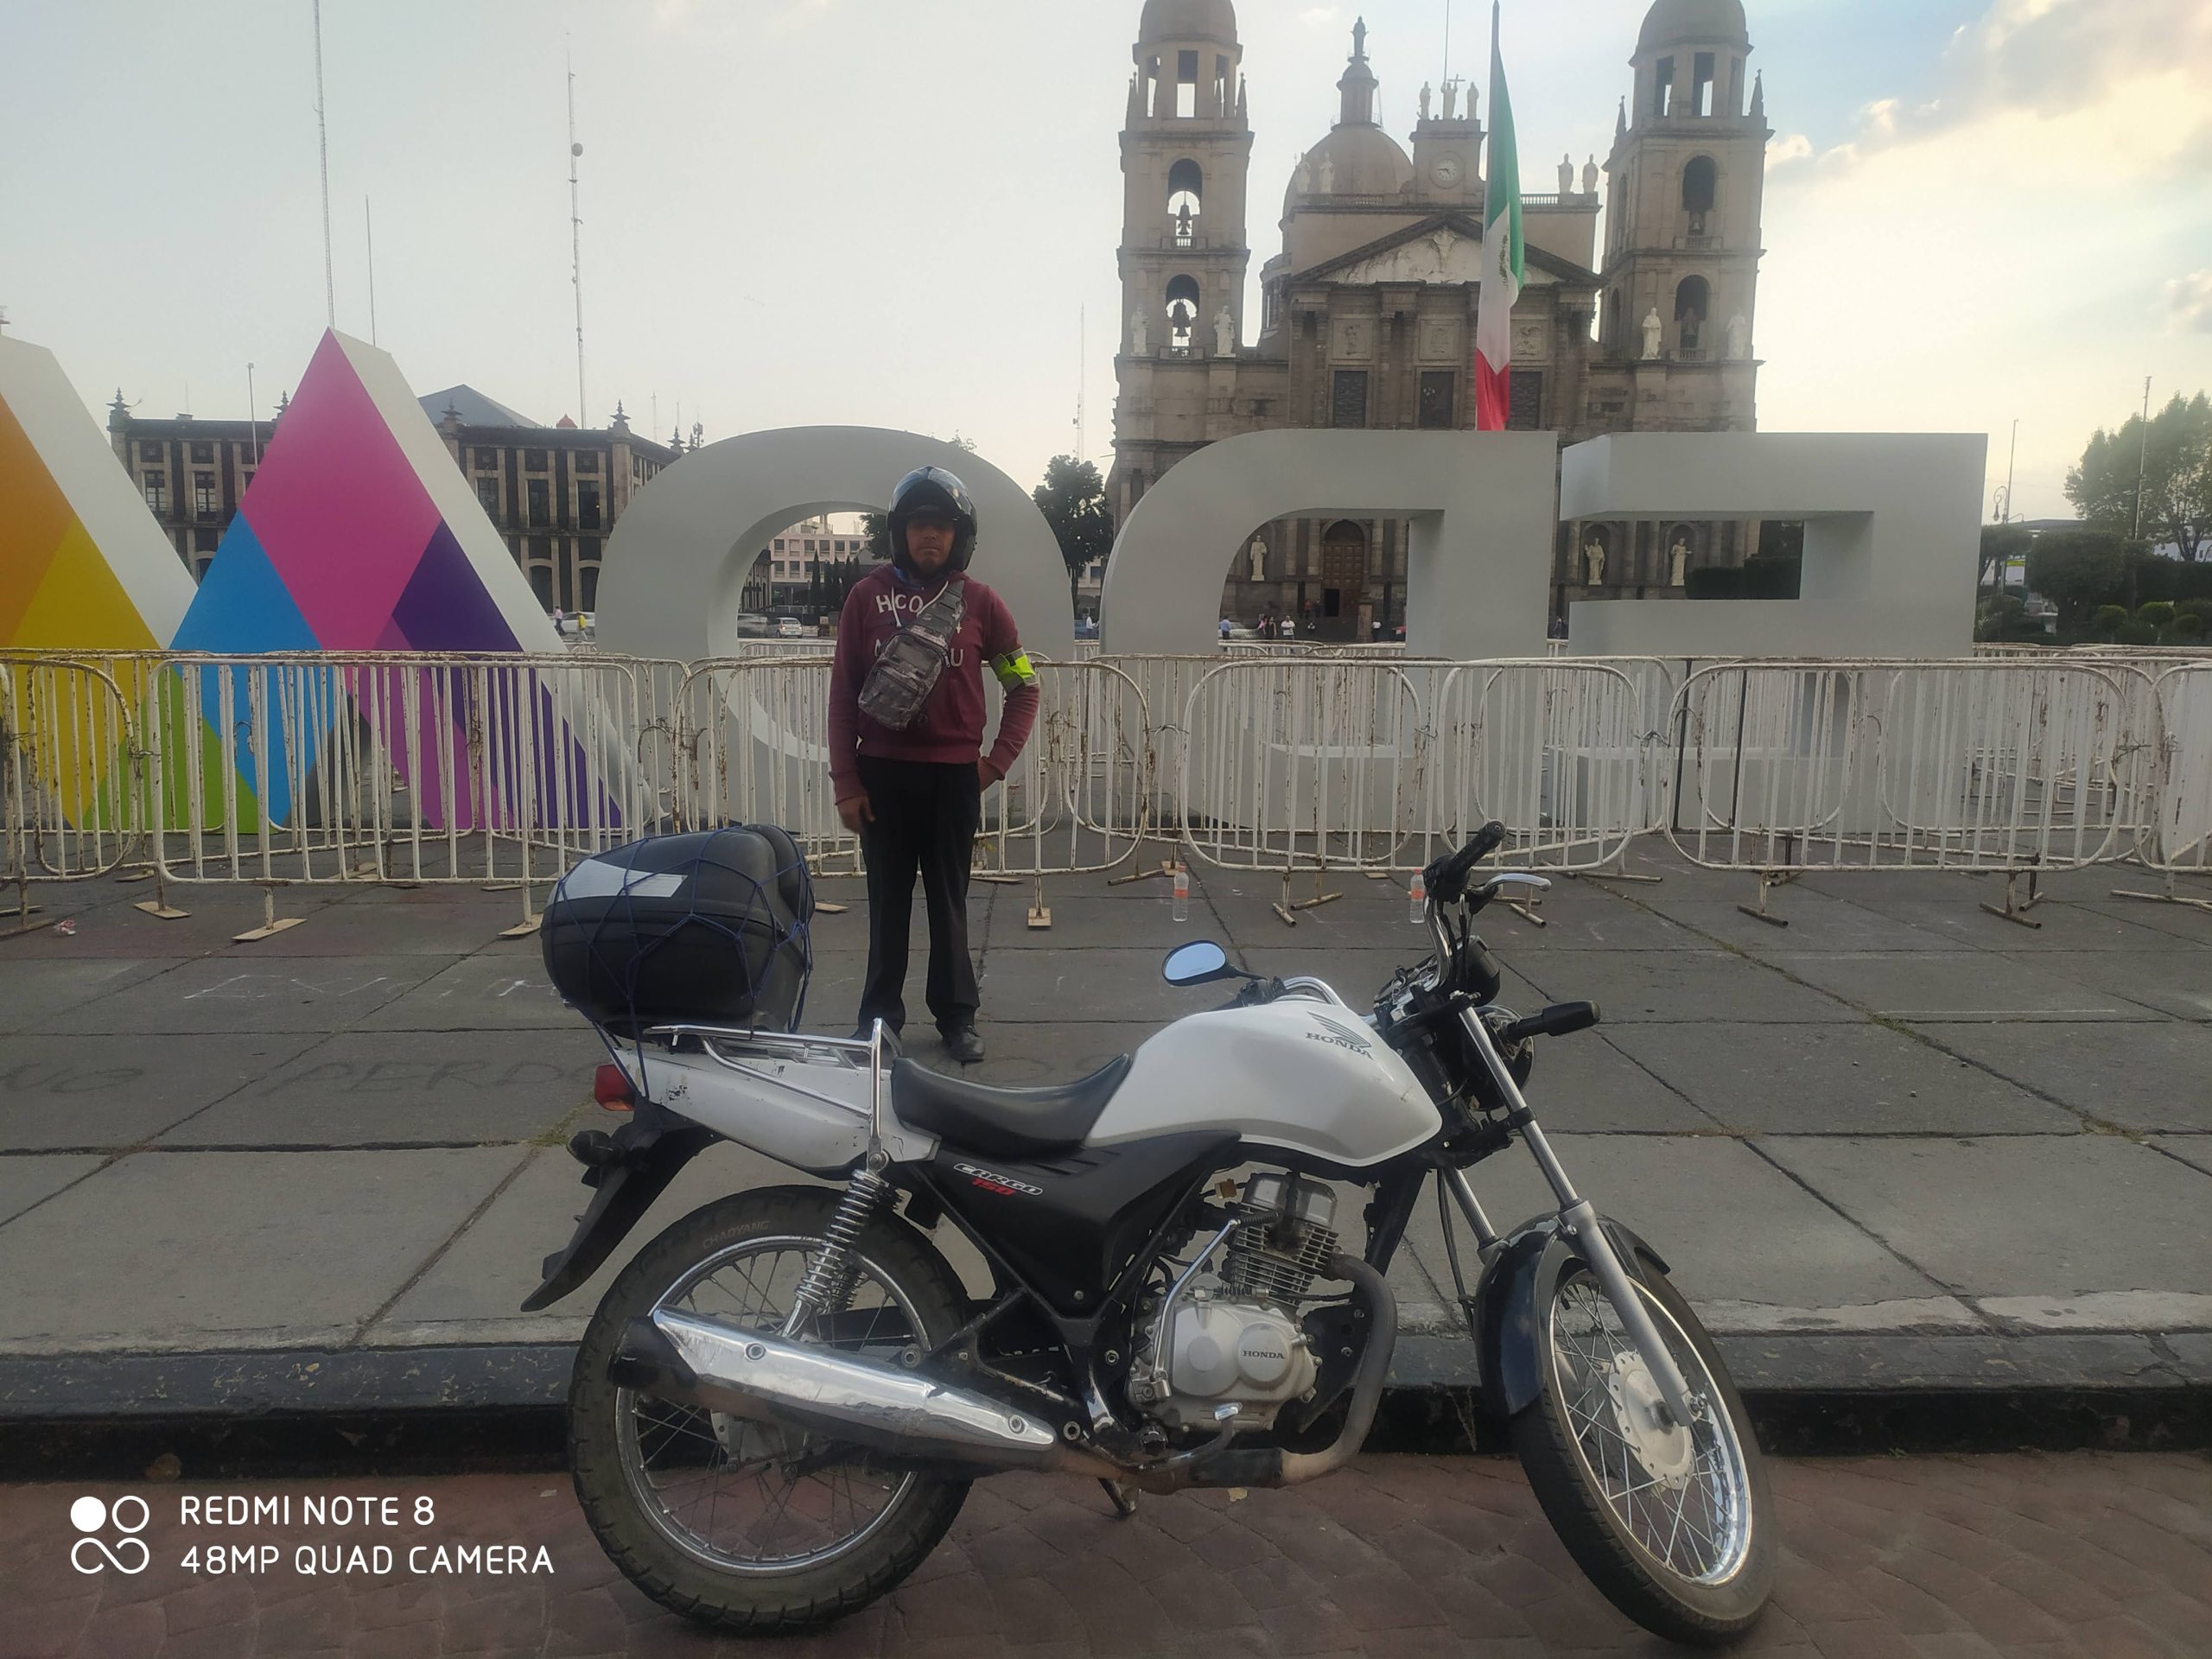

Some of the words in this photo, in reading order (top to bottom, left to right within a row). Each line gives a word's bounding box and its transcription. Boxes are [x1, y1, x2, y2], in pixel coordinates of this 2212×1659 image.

[1305, 1032, 1375, 1061] HONDA
[953, 1162, 1044, 1196] CARGO
[970, 1177, 1016, 1196] 150
[702, 1219, 771, 1249] CHAOYANG
[1243, 1350, 1286, 1360] HONDA
